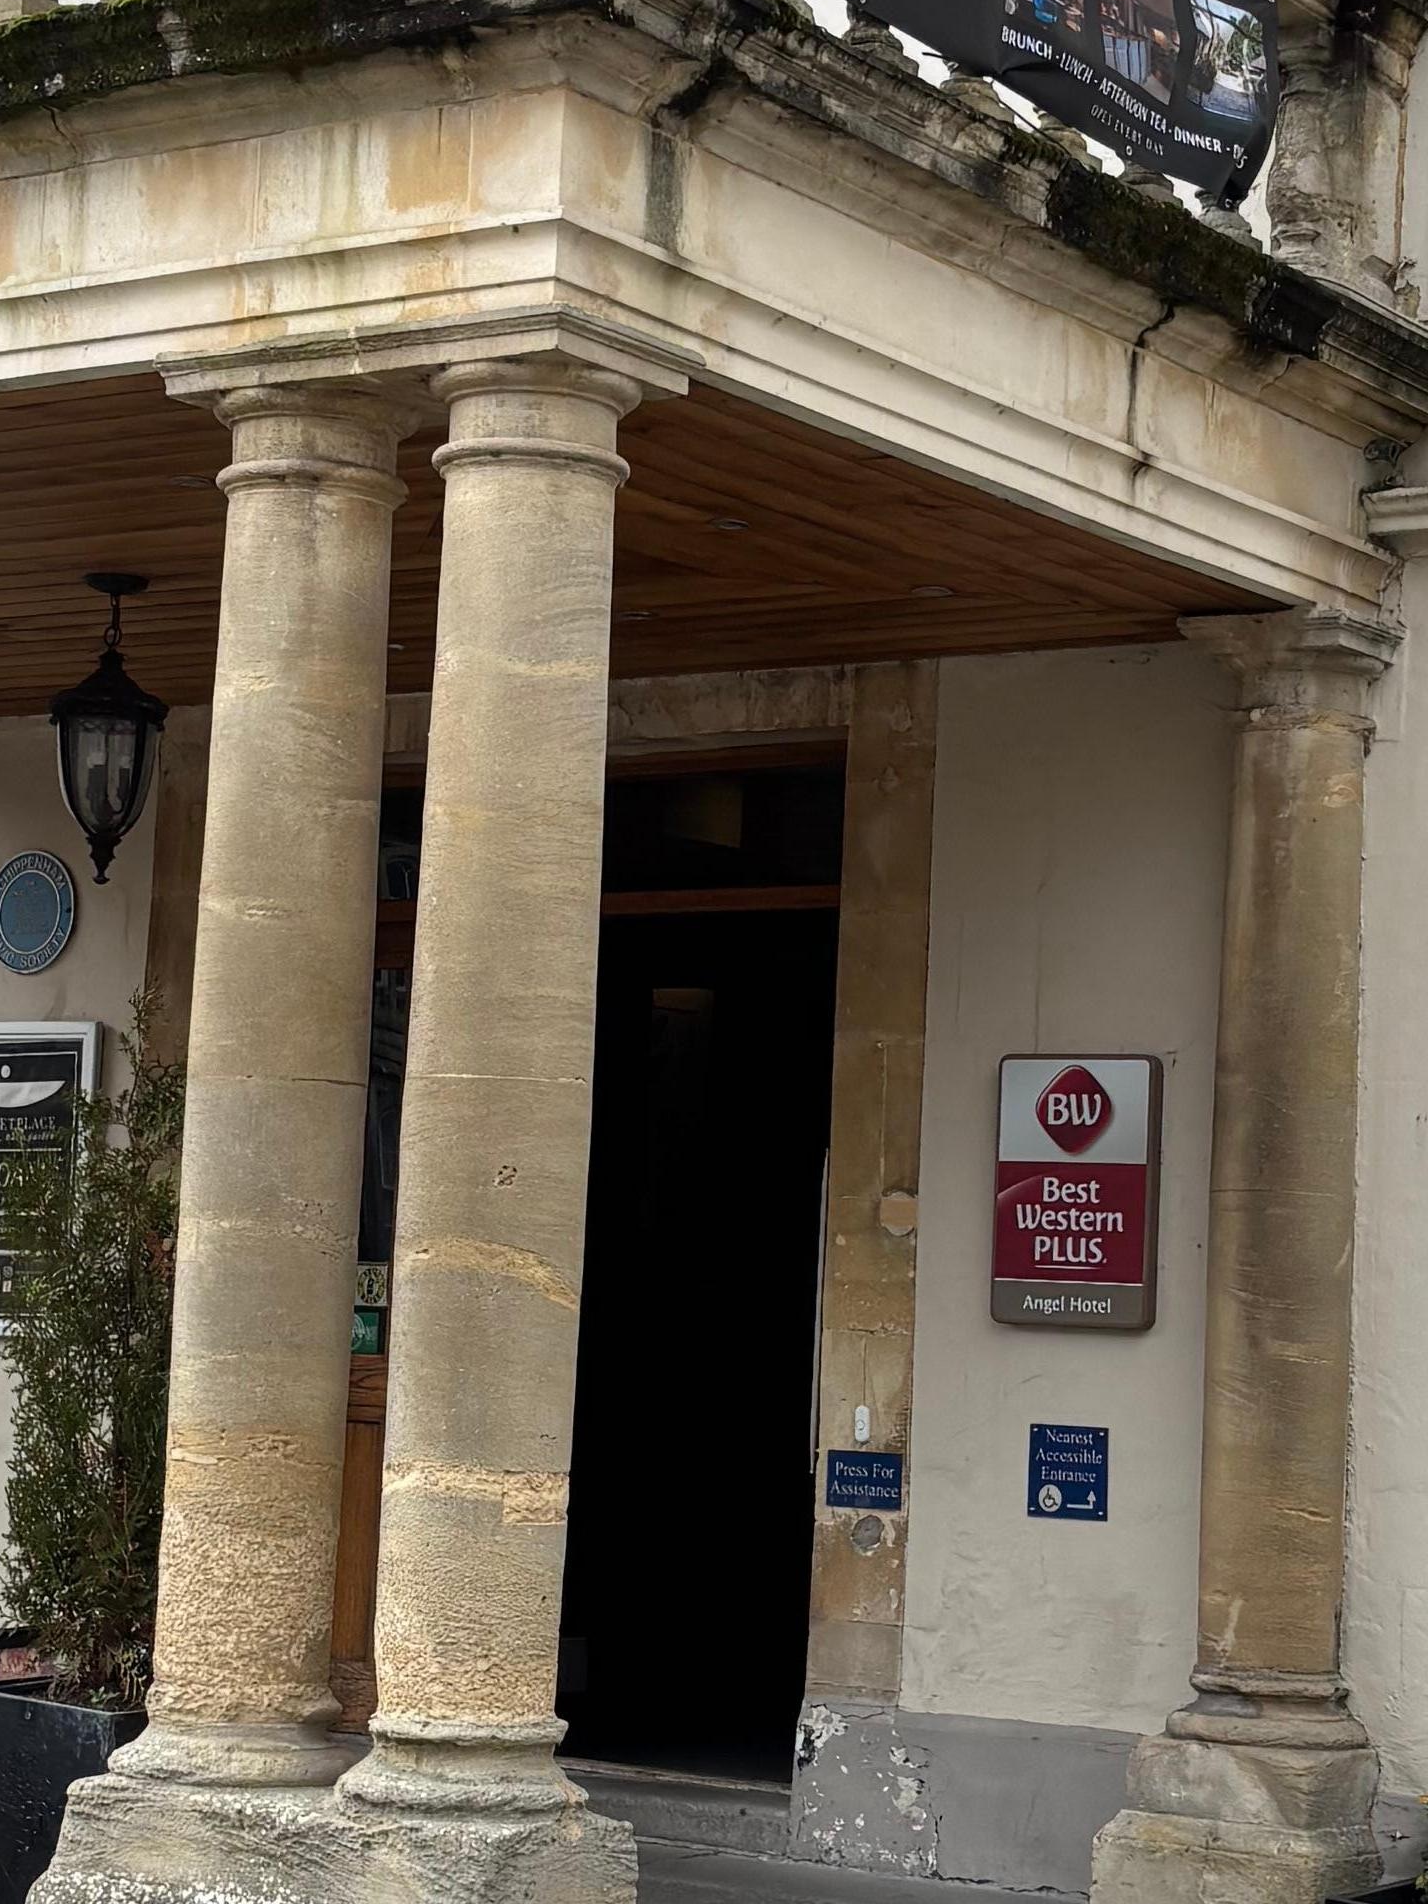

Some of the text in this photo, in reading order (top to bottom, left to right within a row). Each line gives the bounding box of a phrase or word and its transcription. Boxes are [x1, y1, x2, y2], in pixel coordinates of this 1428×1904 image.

[1002, 26, 1052, 60] BRUNCH
[1150, 110, 1167, 134] TEA
[1174, 127, 1222, 153] DINNER
[19, 928, 65, 968] SOCIETY
[1047, 1093, 1102, 1126] BW
[1043, 1177, 1100, 1204] Best
[1016, 1204, 1124, 1233] Western
[1023, 1295, 1112, 1315] Angel Hotel
[1046, 1429, 1094, 1445] Nearest
[1035, 1448, 1103, 1465] Accessible
[835, 1461, 895, 1479] Press For
[1041, 1466, 1097, 1483] Entrance
[830, 1480, 900, 1498] Assistance
